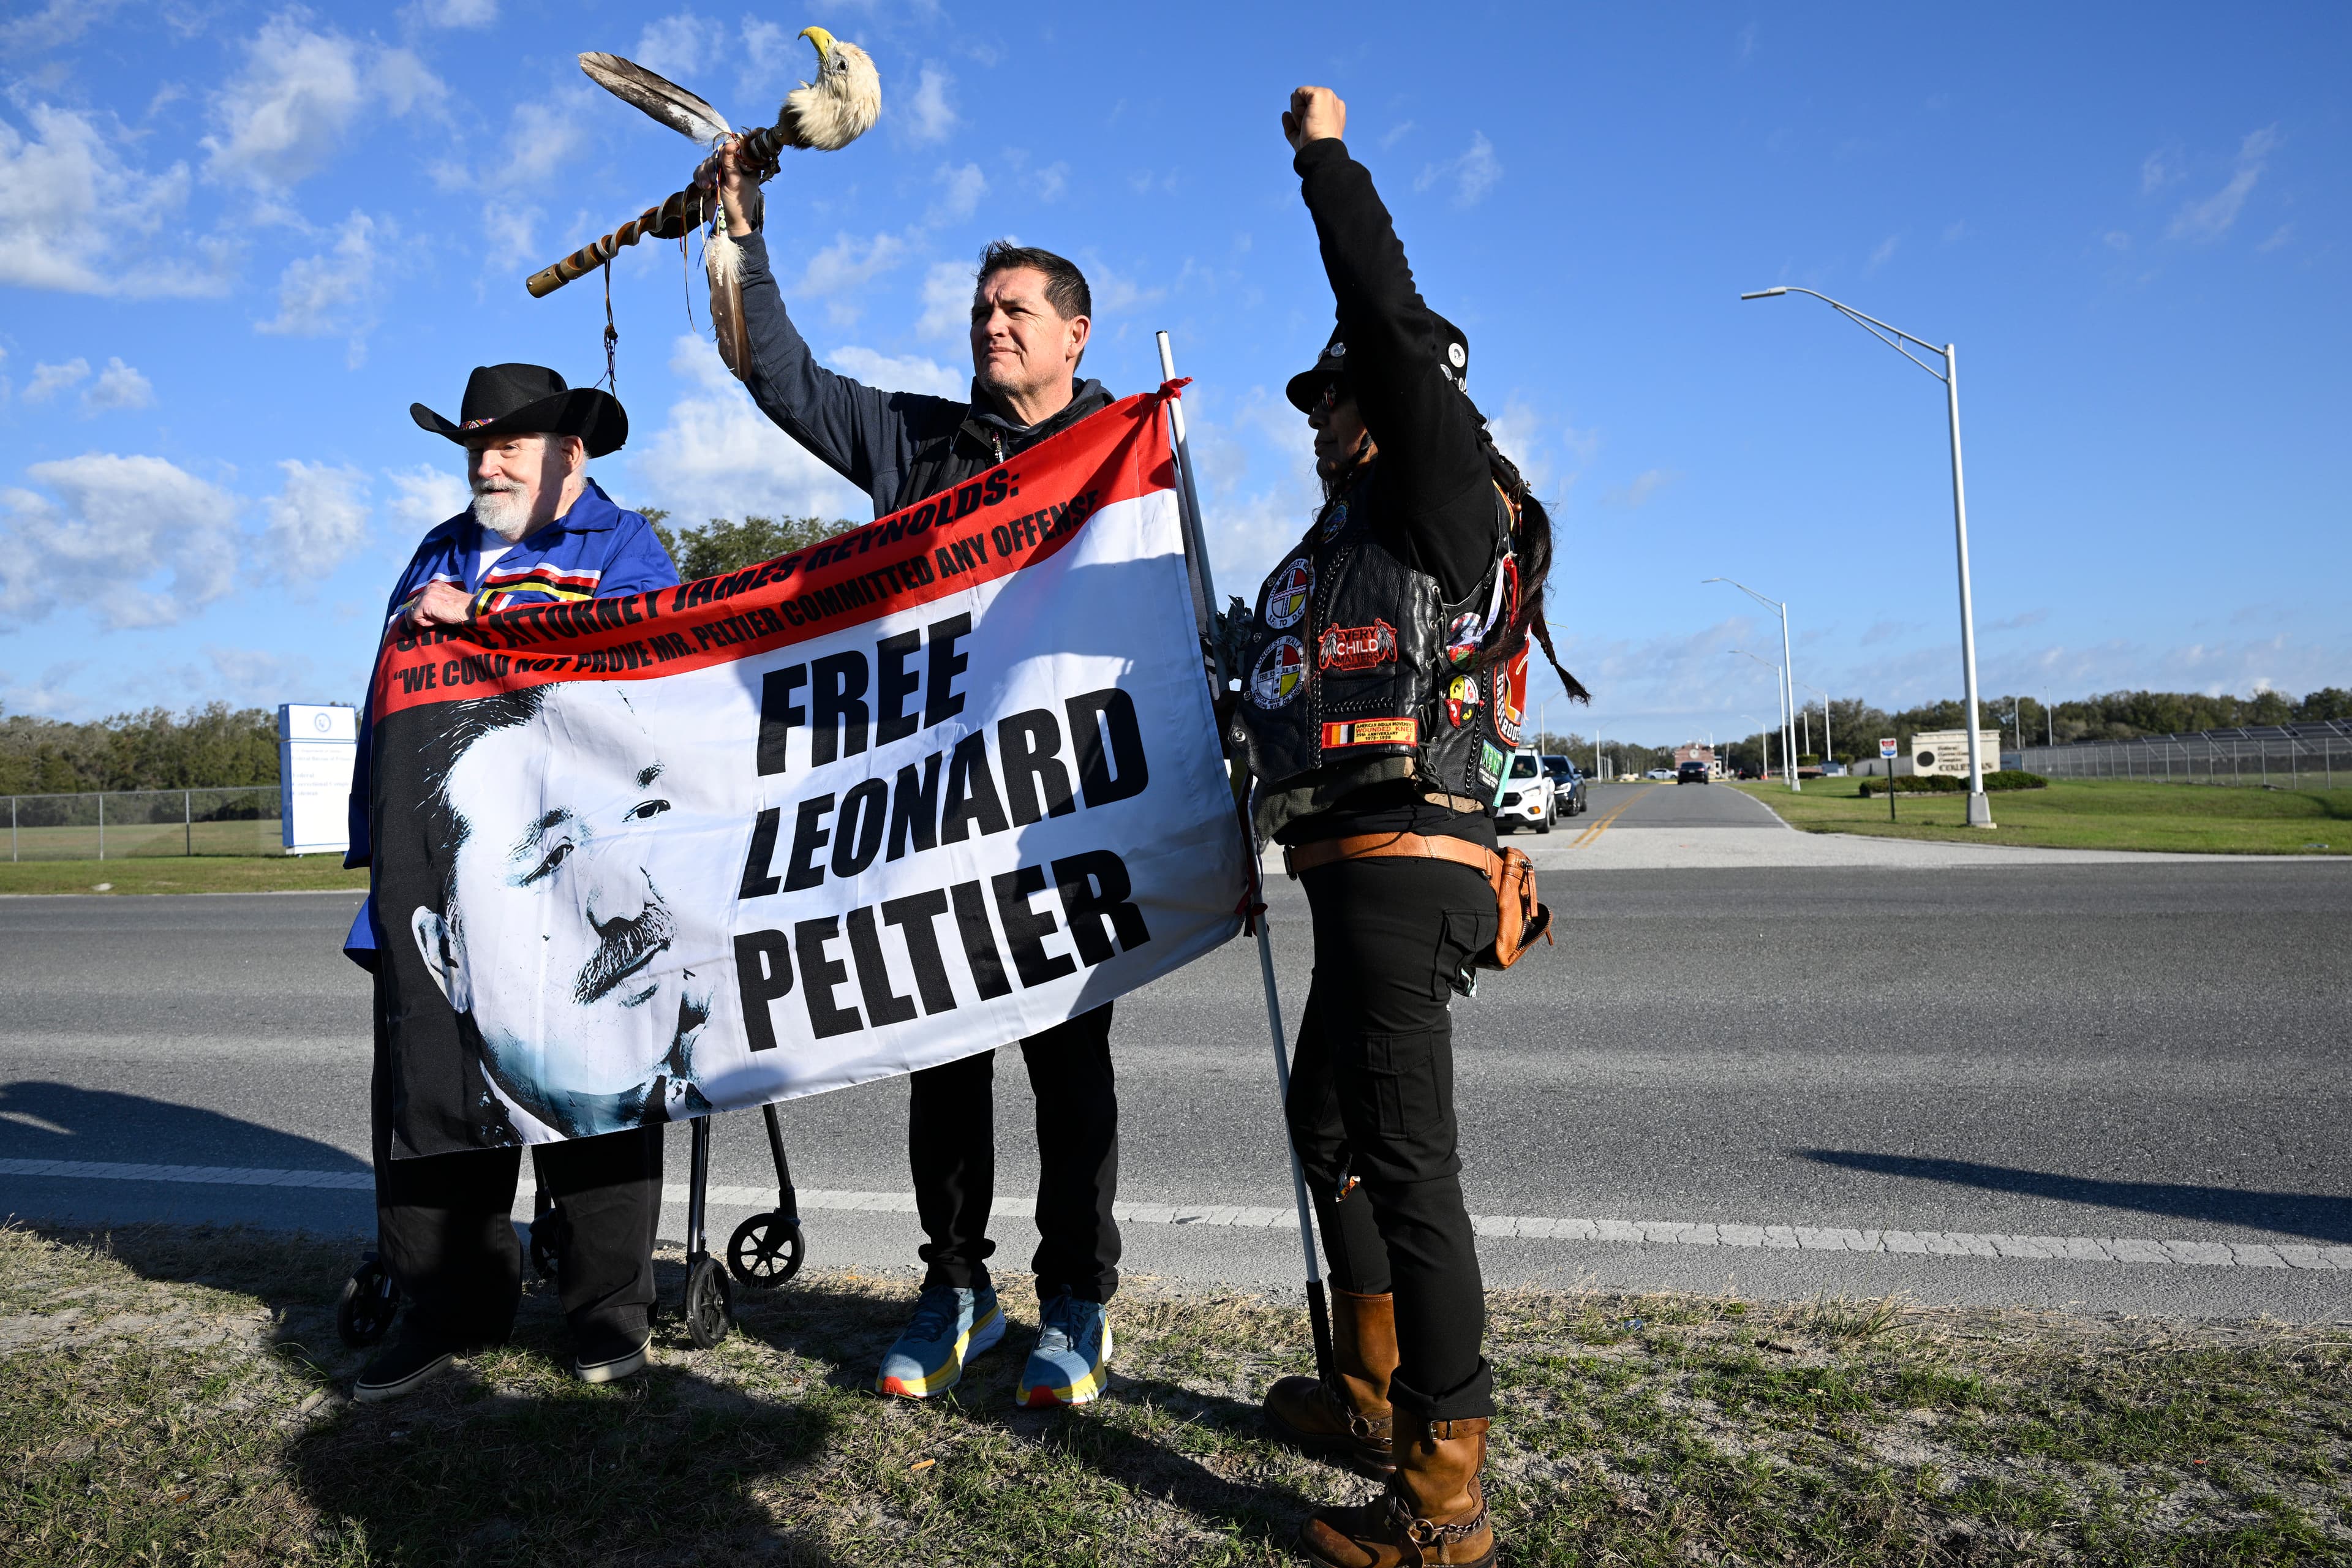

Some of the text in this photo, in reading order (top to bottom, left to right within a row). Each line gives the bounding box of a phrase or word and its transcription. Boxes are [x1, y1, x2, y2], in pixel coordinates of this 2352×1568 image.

[442, 654, 511, 686] COULD
[514, 657, 571, 673] NOT
[572, 638, 653, 673] PROVE
[647, 631, 698, 662] MR.
[690, 607, 785, 650] PELTIER
[780, 556, 935, 626] COMMITTED
[934, 533, 988, 579] ANY
[489, 589, 666, 648] ATTORNEY
[673, 556, 802, 612] JAMES
[805, 469, 1019, 572] REYNOLDS:
[1336, 628, 1377, 642] EVERY
[756, 611, 971, 777] FREE
[1255, 637, 1303, 669] LONGEST WALK
[1336, 639, 1378, 655] CHILD
[1336, 653, 1378, 663] MATTERS
[737, 687, 1149, 900] LEONARD
[733, 850, 1151, 1052] PELTIER
